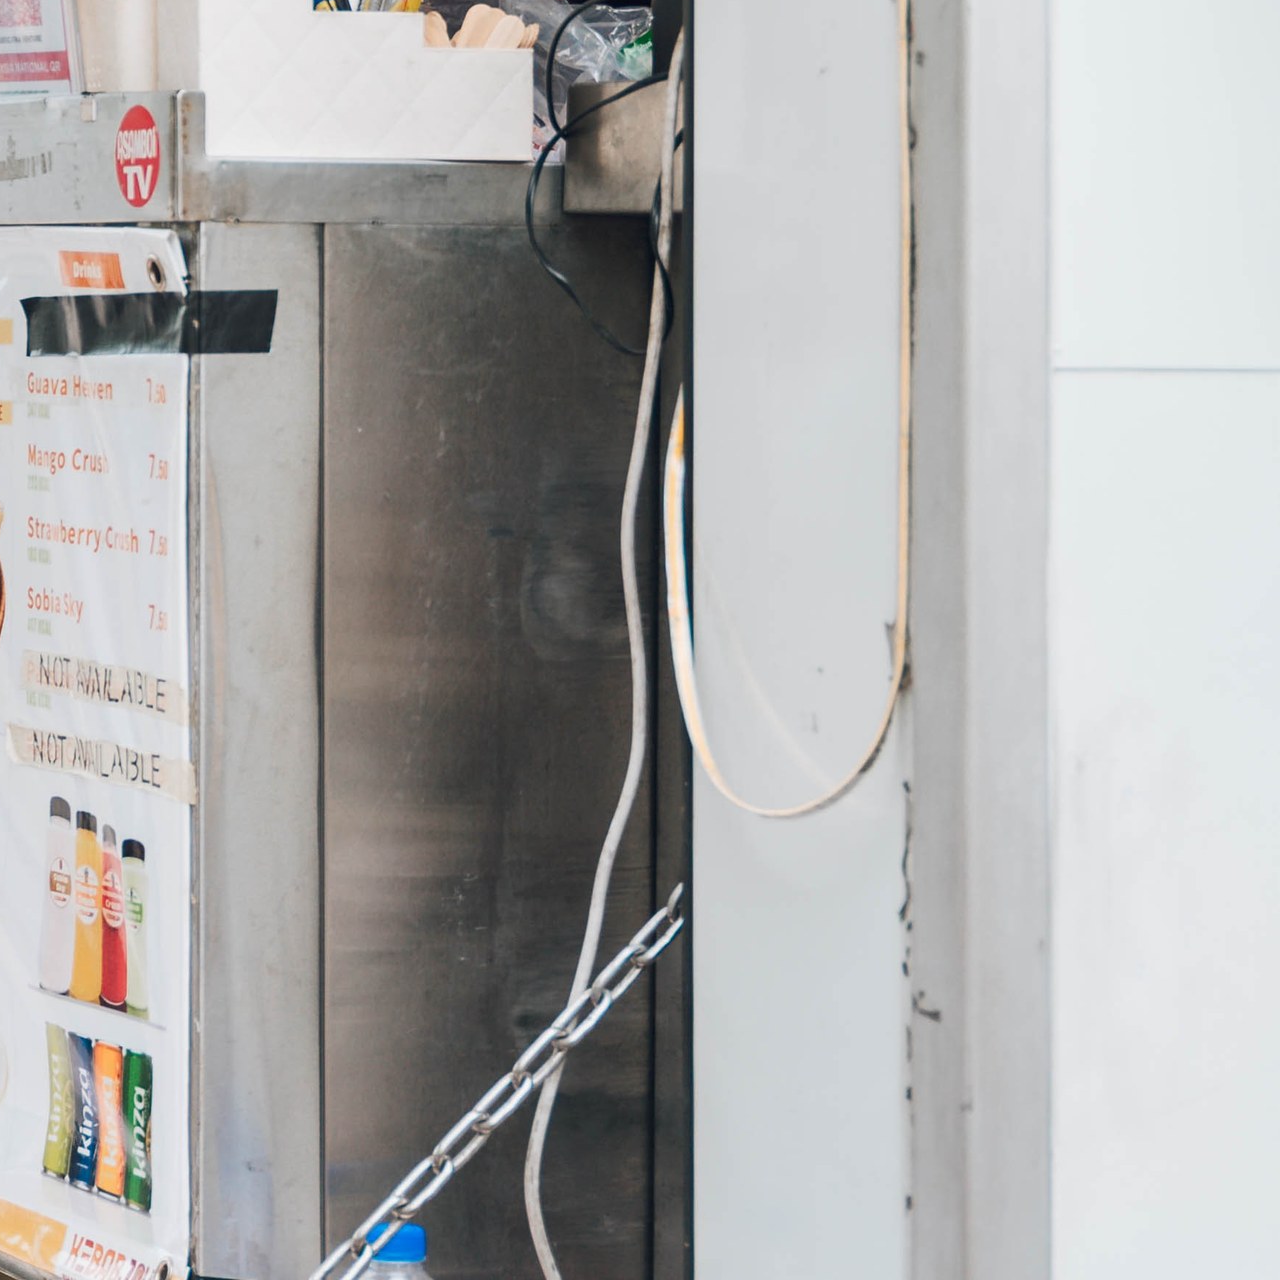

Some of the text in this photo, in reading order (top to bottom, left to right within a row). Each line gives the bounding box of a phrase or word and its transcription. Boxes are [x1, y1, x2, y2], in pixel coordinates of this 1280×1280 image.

[123, 164, 153, 200] TV
[73, 262, 101, 279] Drinks
[27, 372, 68, 395] Guava
[28, 444, 108, 475] Mango Crush
[27, 516, 101, 553] Strawberry
[27, 587, 84, 623] Sobia Sky
[39, 654, 70, 689] NOT
[76, 660, 167, 713] AVAILABLE
[32, 730, 161, 788] NOT AVAILABLE
[77, 1066, 95, 1158] kinza
[131, 1085, 147, 1179] kinza
